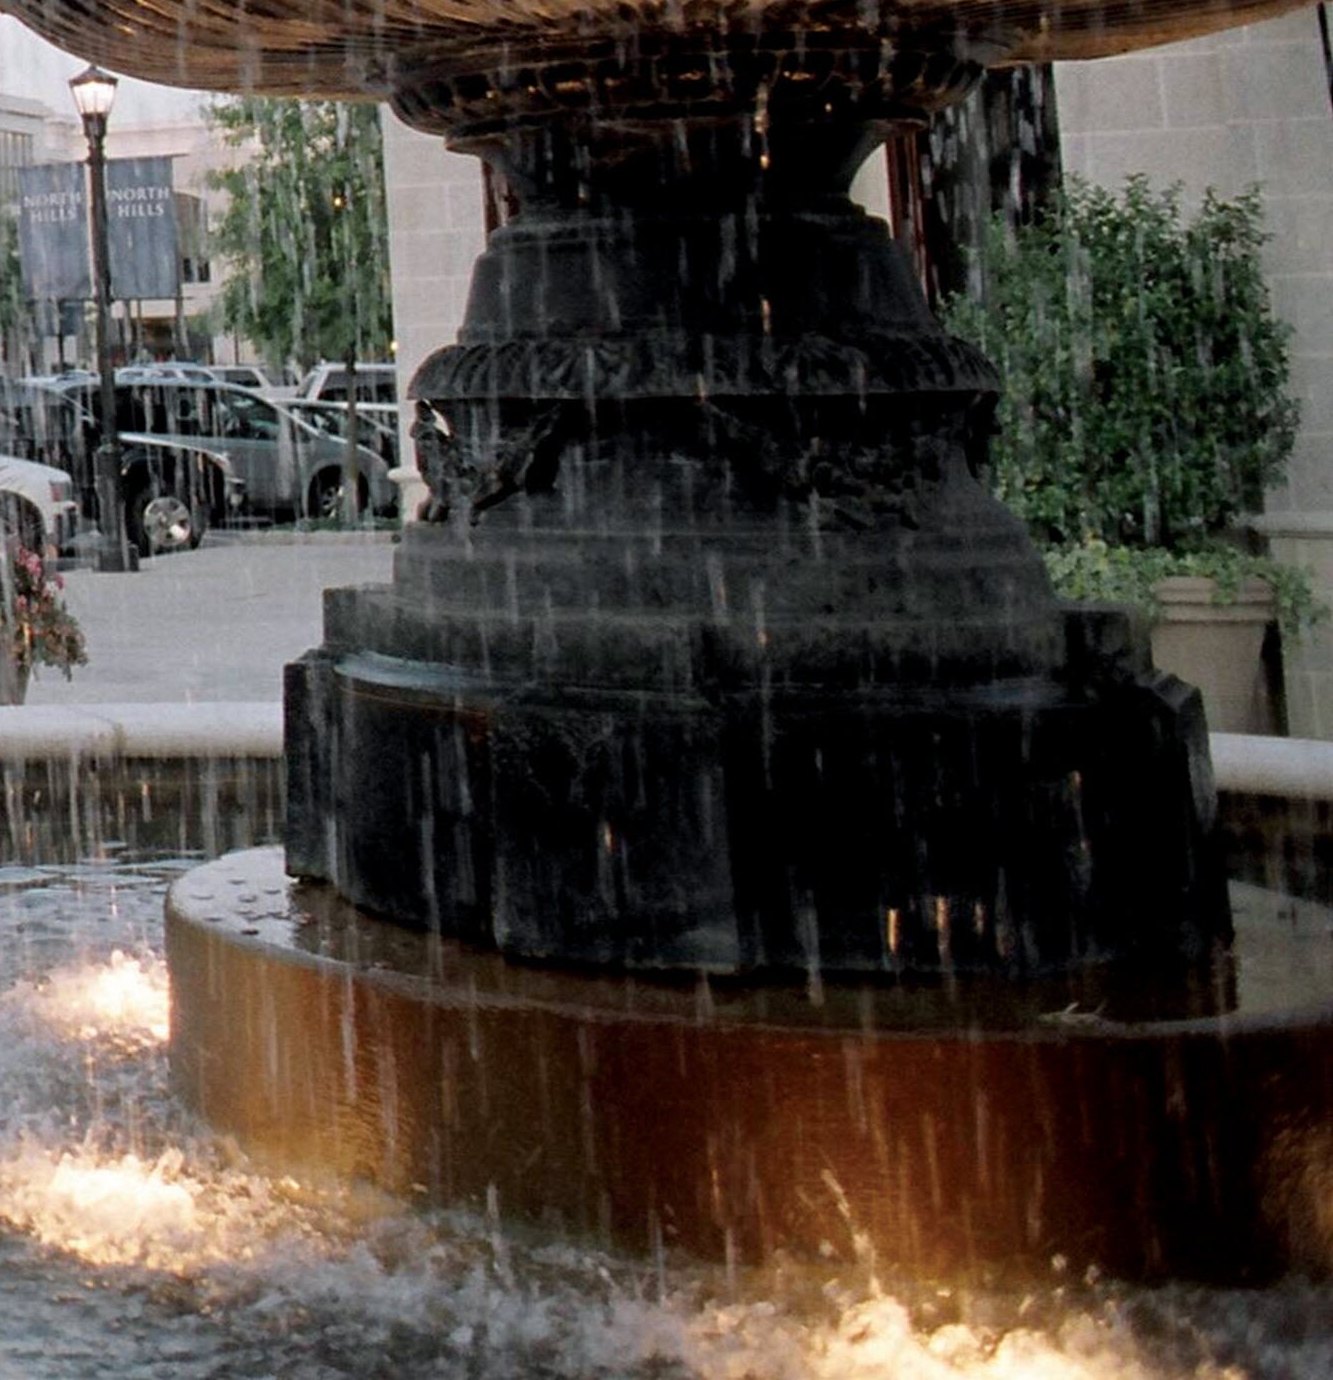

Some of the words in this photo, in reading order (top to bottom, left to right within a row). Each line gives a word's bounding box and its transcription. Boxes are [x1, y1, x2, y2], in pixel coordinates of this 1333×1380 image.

[23, 191, 81, 208] NORTH
[110, 186, 170, 202] NORTH
[30, 206, 77, 222] HILLS
[117, 203, 165, 218] HILLS
